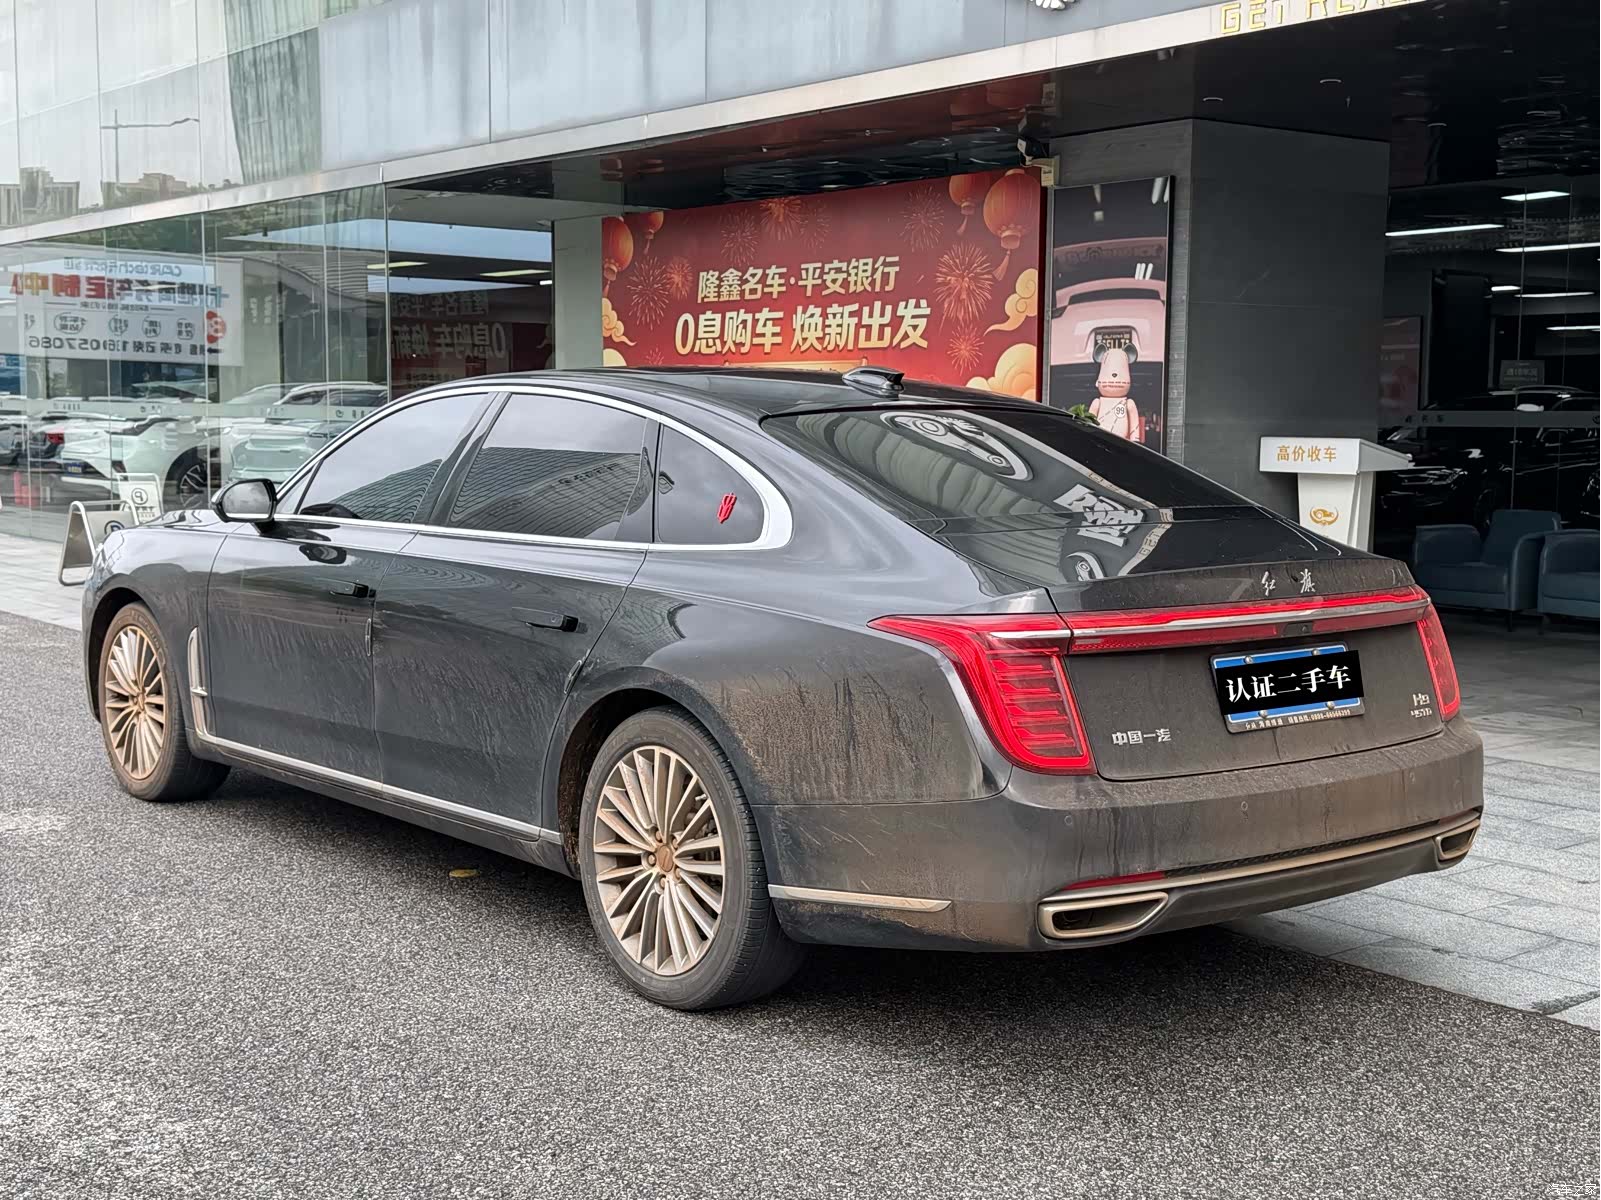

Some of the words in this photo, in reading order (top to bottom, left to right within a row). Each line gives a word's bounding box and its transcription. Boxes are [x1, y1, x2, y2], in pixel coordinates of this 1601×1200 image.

[697, 255, 900, 304] 隆鑫名车·平安银行
[675, 307, 784, 355] 0息购车
[790, 298, 931, 353] 焕新出发
[1115, 406, 1125, 416] 99
[1276, 445, 1337, 462] 高价收车
[1112, 728, 1172, 746] 中国一汽
